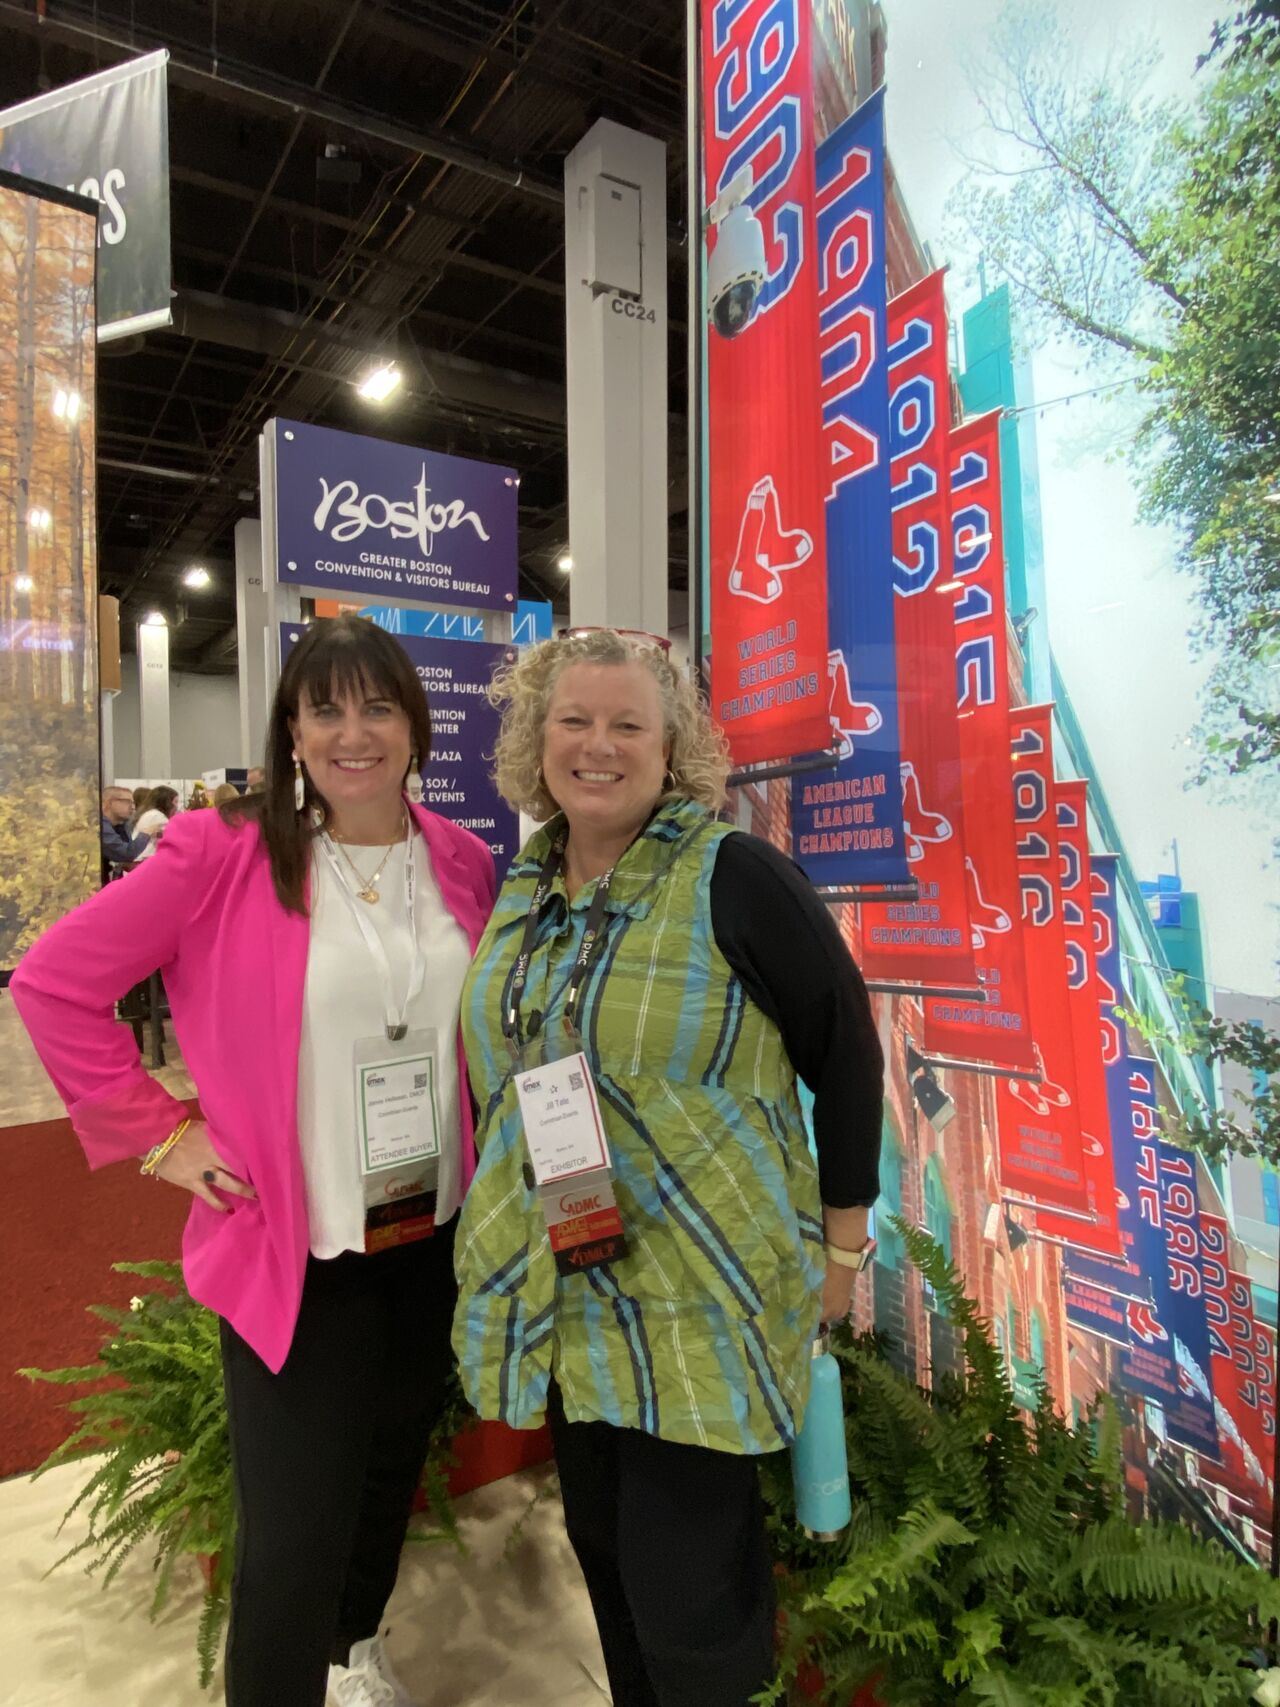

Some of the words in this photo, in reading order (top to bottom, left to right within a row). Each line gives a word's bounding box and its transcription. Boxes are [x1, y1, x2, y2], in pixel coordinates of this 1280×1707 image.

[611, 298, 656, 324] CC24
[314, 461, 490, 557] Boston
[360, 552, 407, 569] GREATER
[410, 559, 452, 575] BOSTON
[315, 559, 392, 581] CONVENTION
[395, 571, 402, 582] &
[406, 573, 450, 589] VISITORS
[452, 580, 490, 595] BUREAU
[737, 619, 797, 661] WORLD
[416, 666, 452, 679] OSTON
[739, 650, 797, 689] SERIES
[721, 673, 819, 721] CHAMPIONS
[430, 709, 466, 721] ENTION
[430, 750, 462, 761] PLAZA
[426, 778, 448, 789] SOX
[802, 774, 886, 805] AMERICAN
[429, 792, 465, 802] EVENTS
[814, 803, 875, 828] LEAGUE
[800, 827, 894, 854] CHAMPIONS
[887, 904, 940, 921] SERIES
[871, 927, 962, 946] CHAMPIONS
[577, 943, 592, 967] DMC
[933, 1005, 1022, 1030] CHAMPIONS
[371, 1148, 408, 1163] ATTENDEE
[409, 1142, 433, 1154] BUYER
[550, 1156, 588, 1174] EXHIBITOR
[1160, 1156, 1202, 1298] 1986
[1200, 1225, 1232, 1360] 2004
